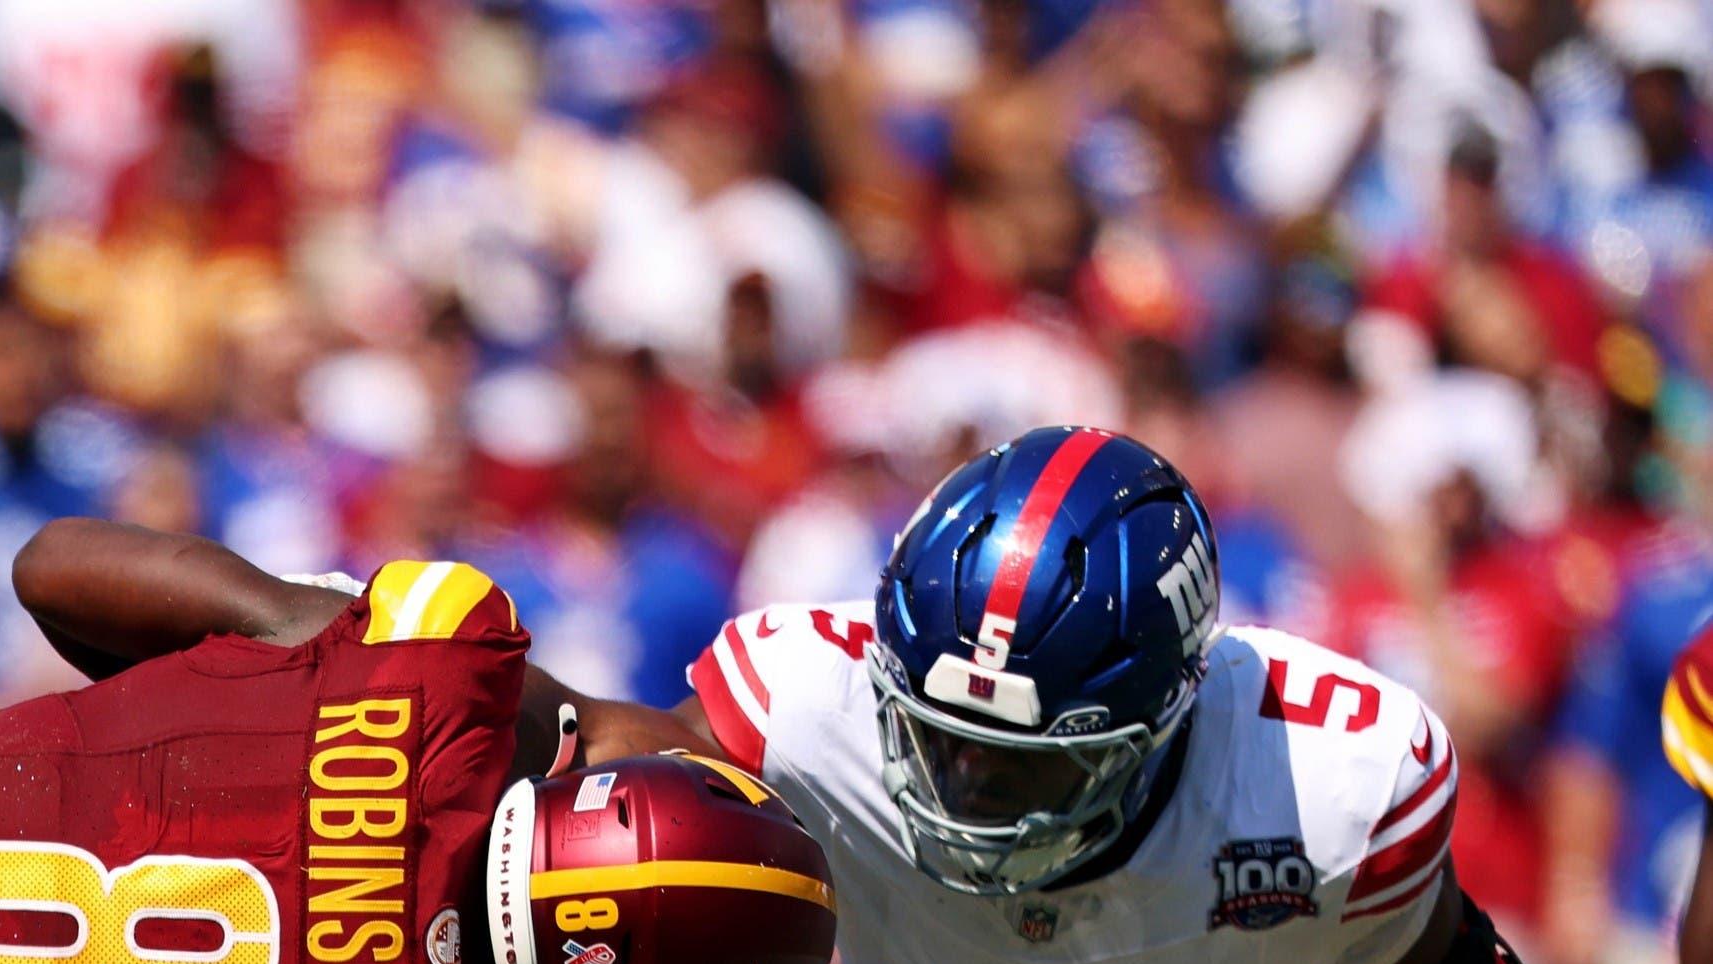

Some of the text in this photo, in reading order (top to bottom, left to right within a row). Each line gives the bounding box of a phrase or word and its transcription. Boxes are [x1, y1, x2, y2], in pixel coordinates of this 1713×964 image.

[974, 612, 1016, 671] 5
[1259, 657, 1381, 732] 5
[1218, 856, 1313, 902] 100
[555, 897, 619, 932] 8
